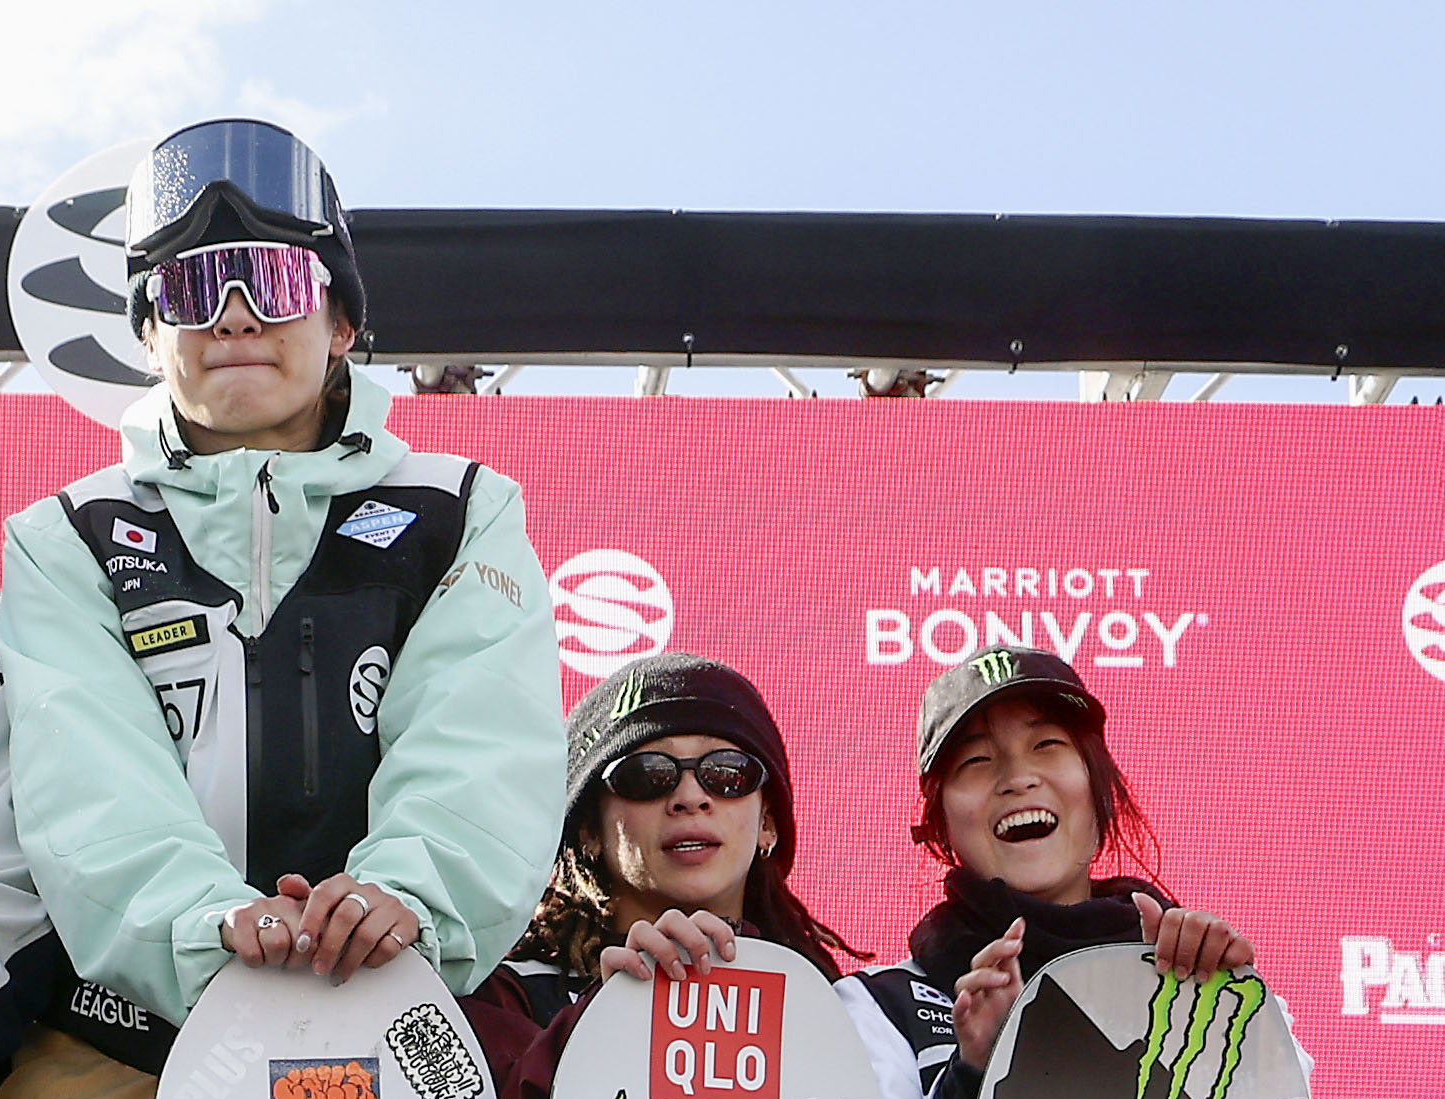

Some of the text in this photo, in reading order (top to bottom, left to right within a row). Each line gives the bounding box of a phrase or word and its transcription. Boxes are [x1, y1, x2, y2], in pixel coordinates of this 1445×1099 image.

[351, 514, 404, 532] ASPEN
[106, 556, 168, 576] TOTSUKA
[122, 578, 141, 592] JPN
[910, 567, 1150, 599] MARRIOTT
[141, 625, 188, 646] LEADER
[866, 609, 1198, 667] BONVOY
[70, 986, 150, 1032] LEAGUE
[667, 981, 762, 1034] UNI
[665, 1039, 767, 1096] QLO
